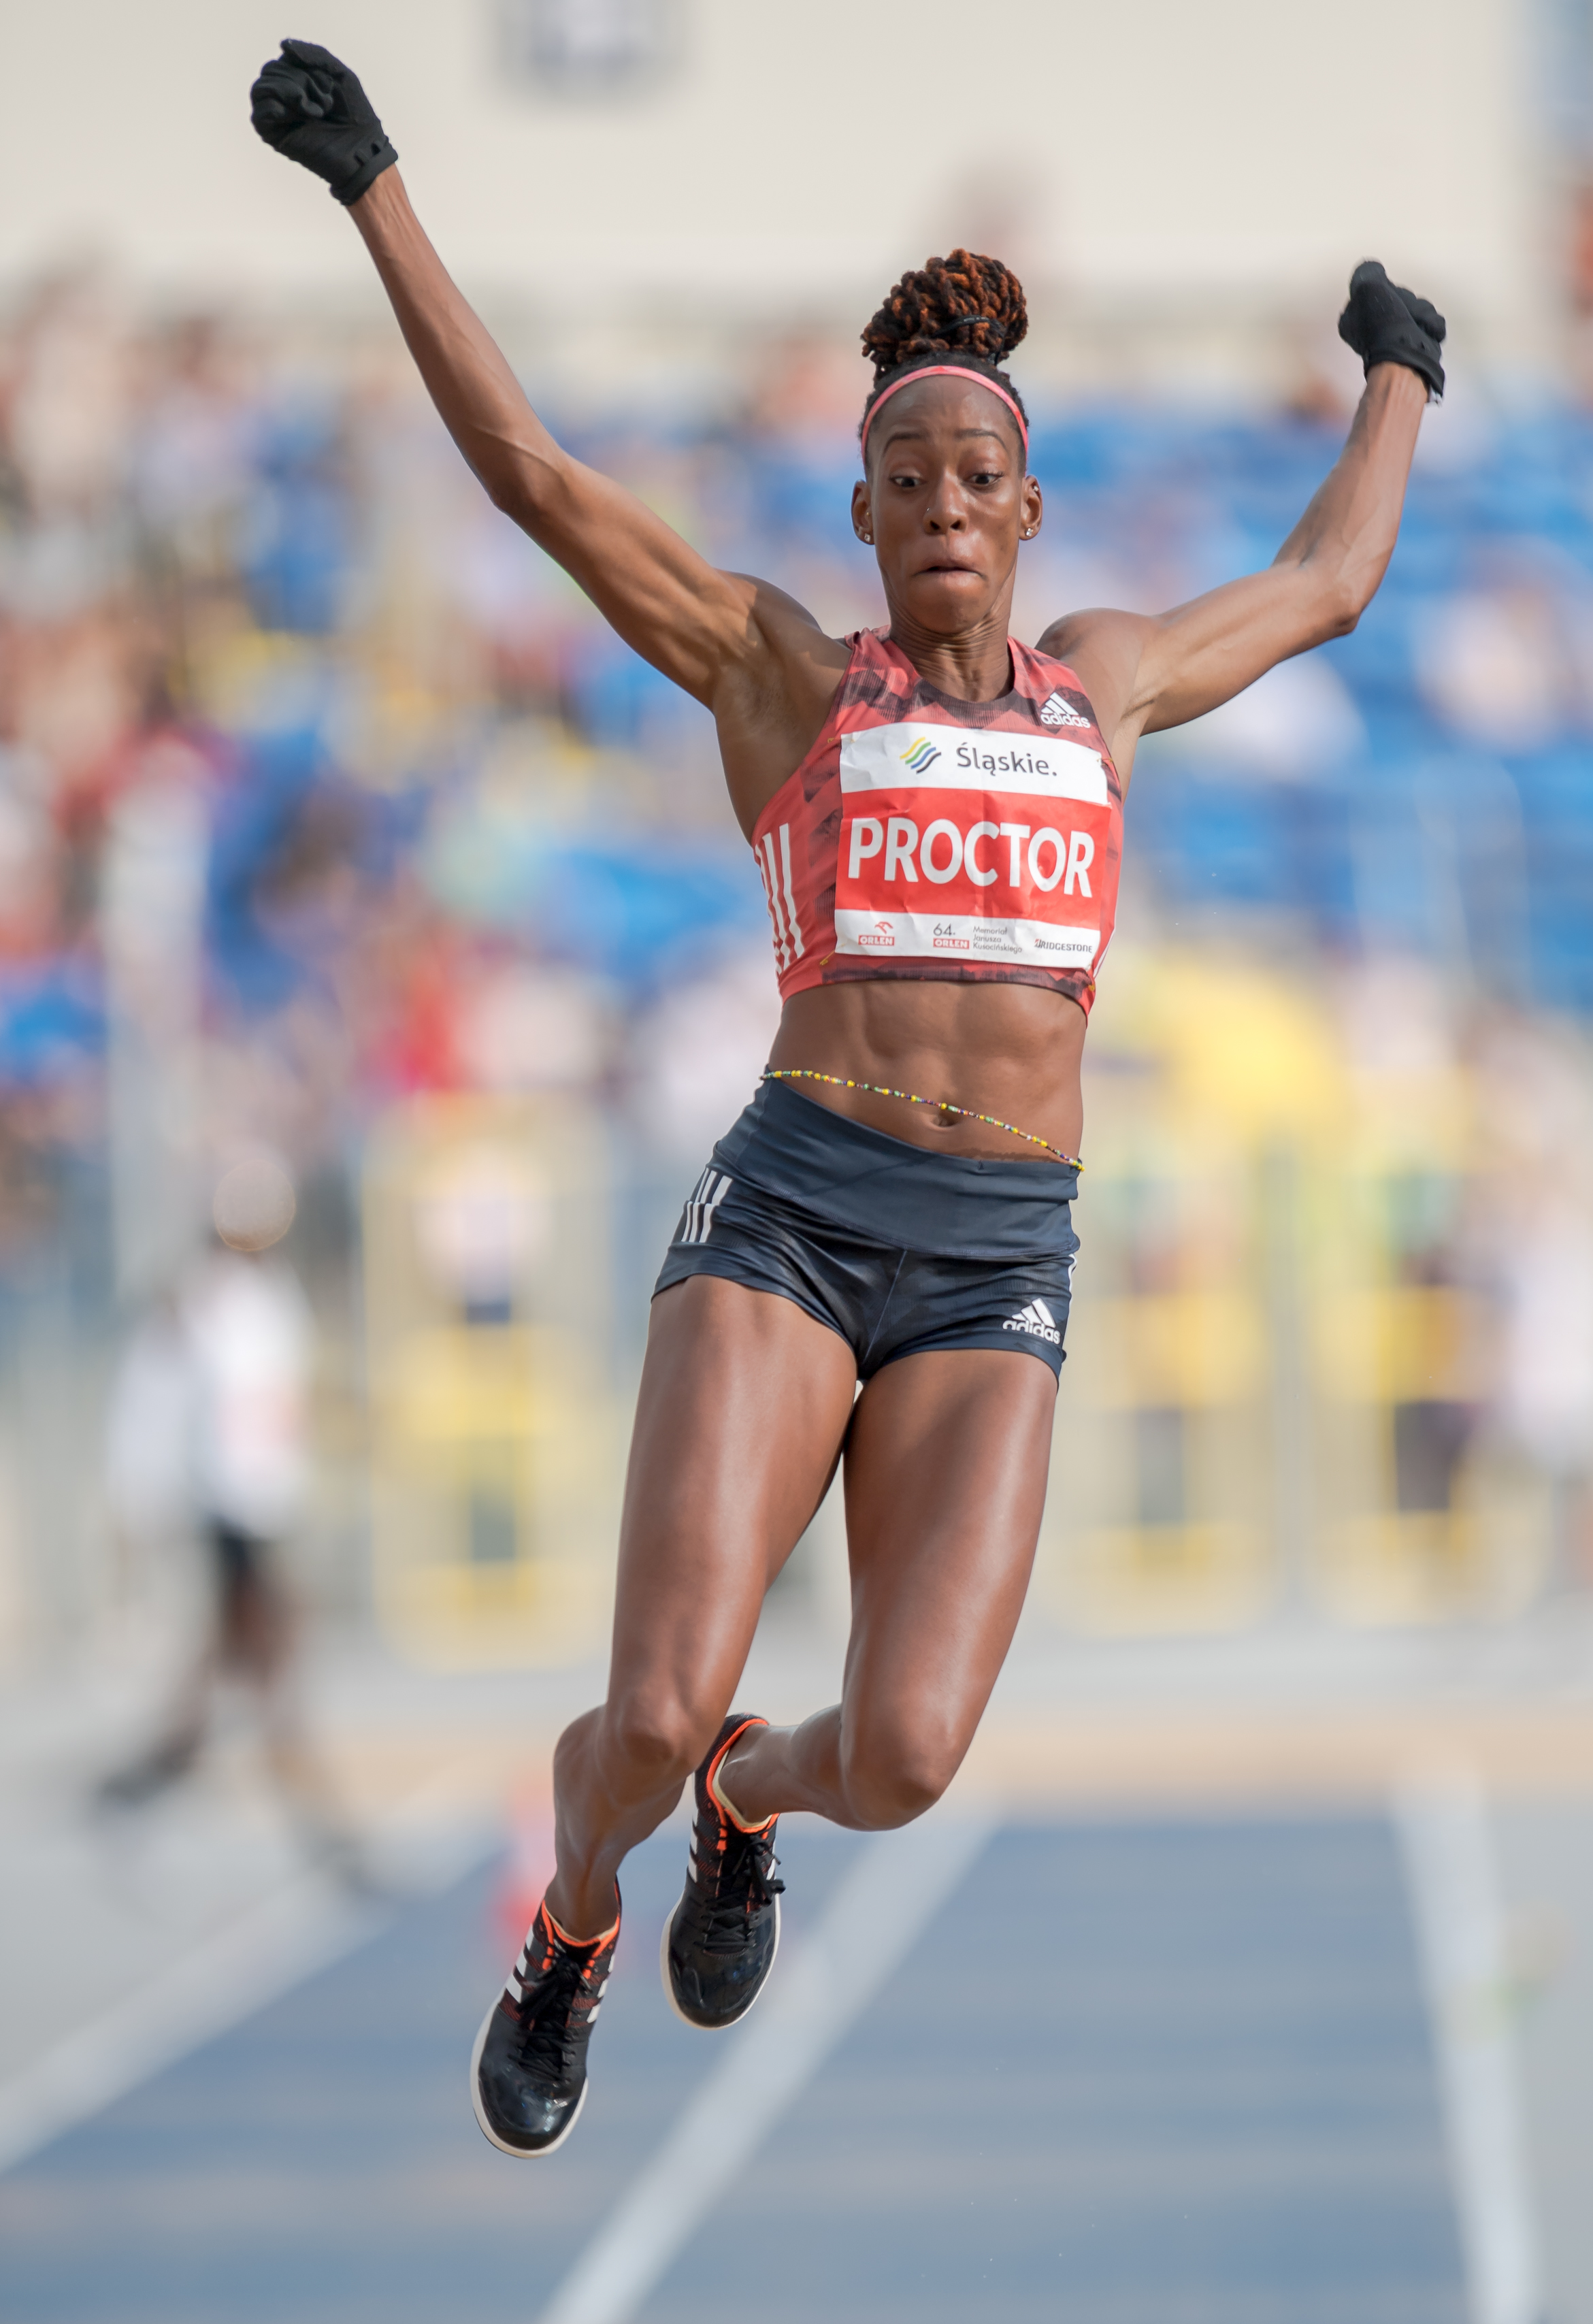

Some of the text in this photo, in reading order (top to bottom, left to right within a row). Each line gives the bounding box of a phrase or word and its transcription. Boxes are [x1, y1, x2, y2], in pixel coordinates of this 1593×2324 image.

[1040, 713, 1091, 729] adidas
[956, 742, 1058, 776] Śląskie.
[848, 817, 1095, 898] PROCTOR
[933, 923, 956, 937] 64.
[972, 926, 1007, 936] Memoriał
[859, 936, 893, 946] ORLEN
[934, 939, 968, 949] ORLEN
[972, 934, 1002, 943] Janusza
[1034, 938, 1093, 953] BRIDGESTONE
[972, 942, 1023, 955] Kusocińskiego
[1002, 1320, 1060, 1345] adidas
